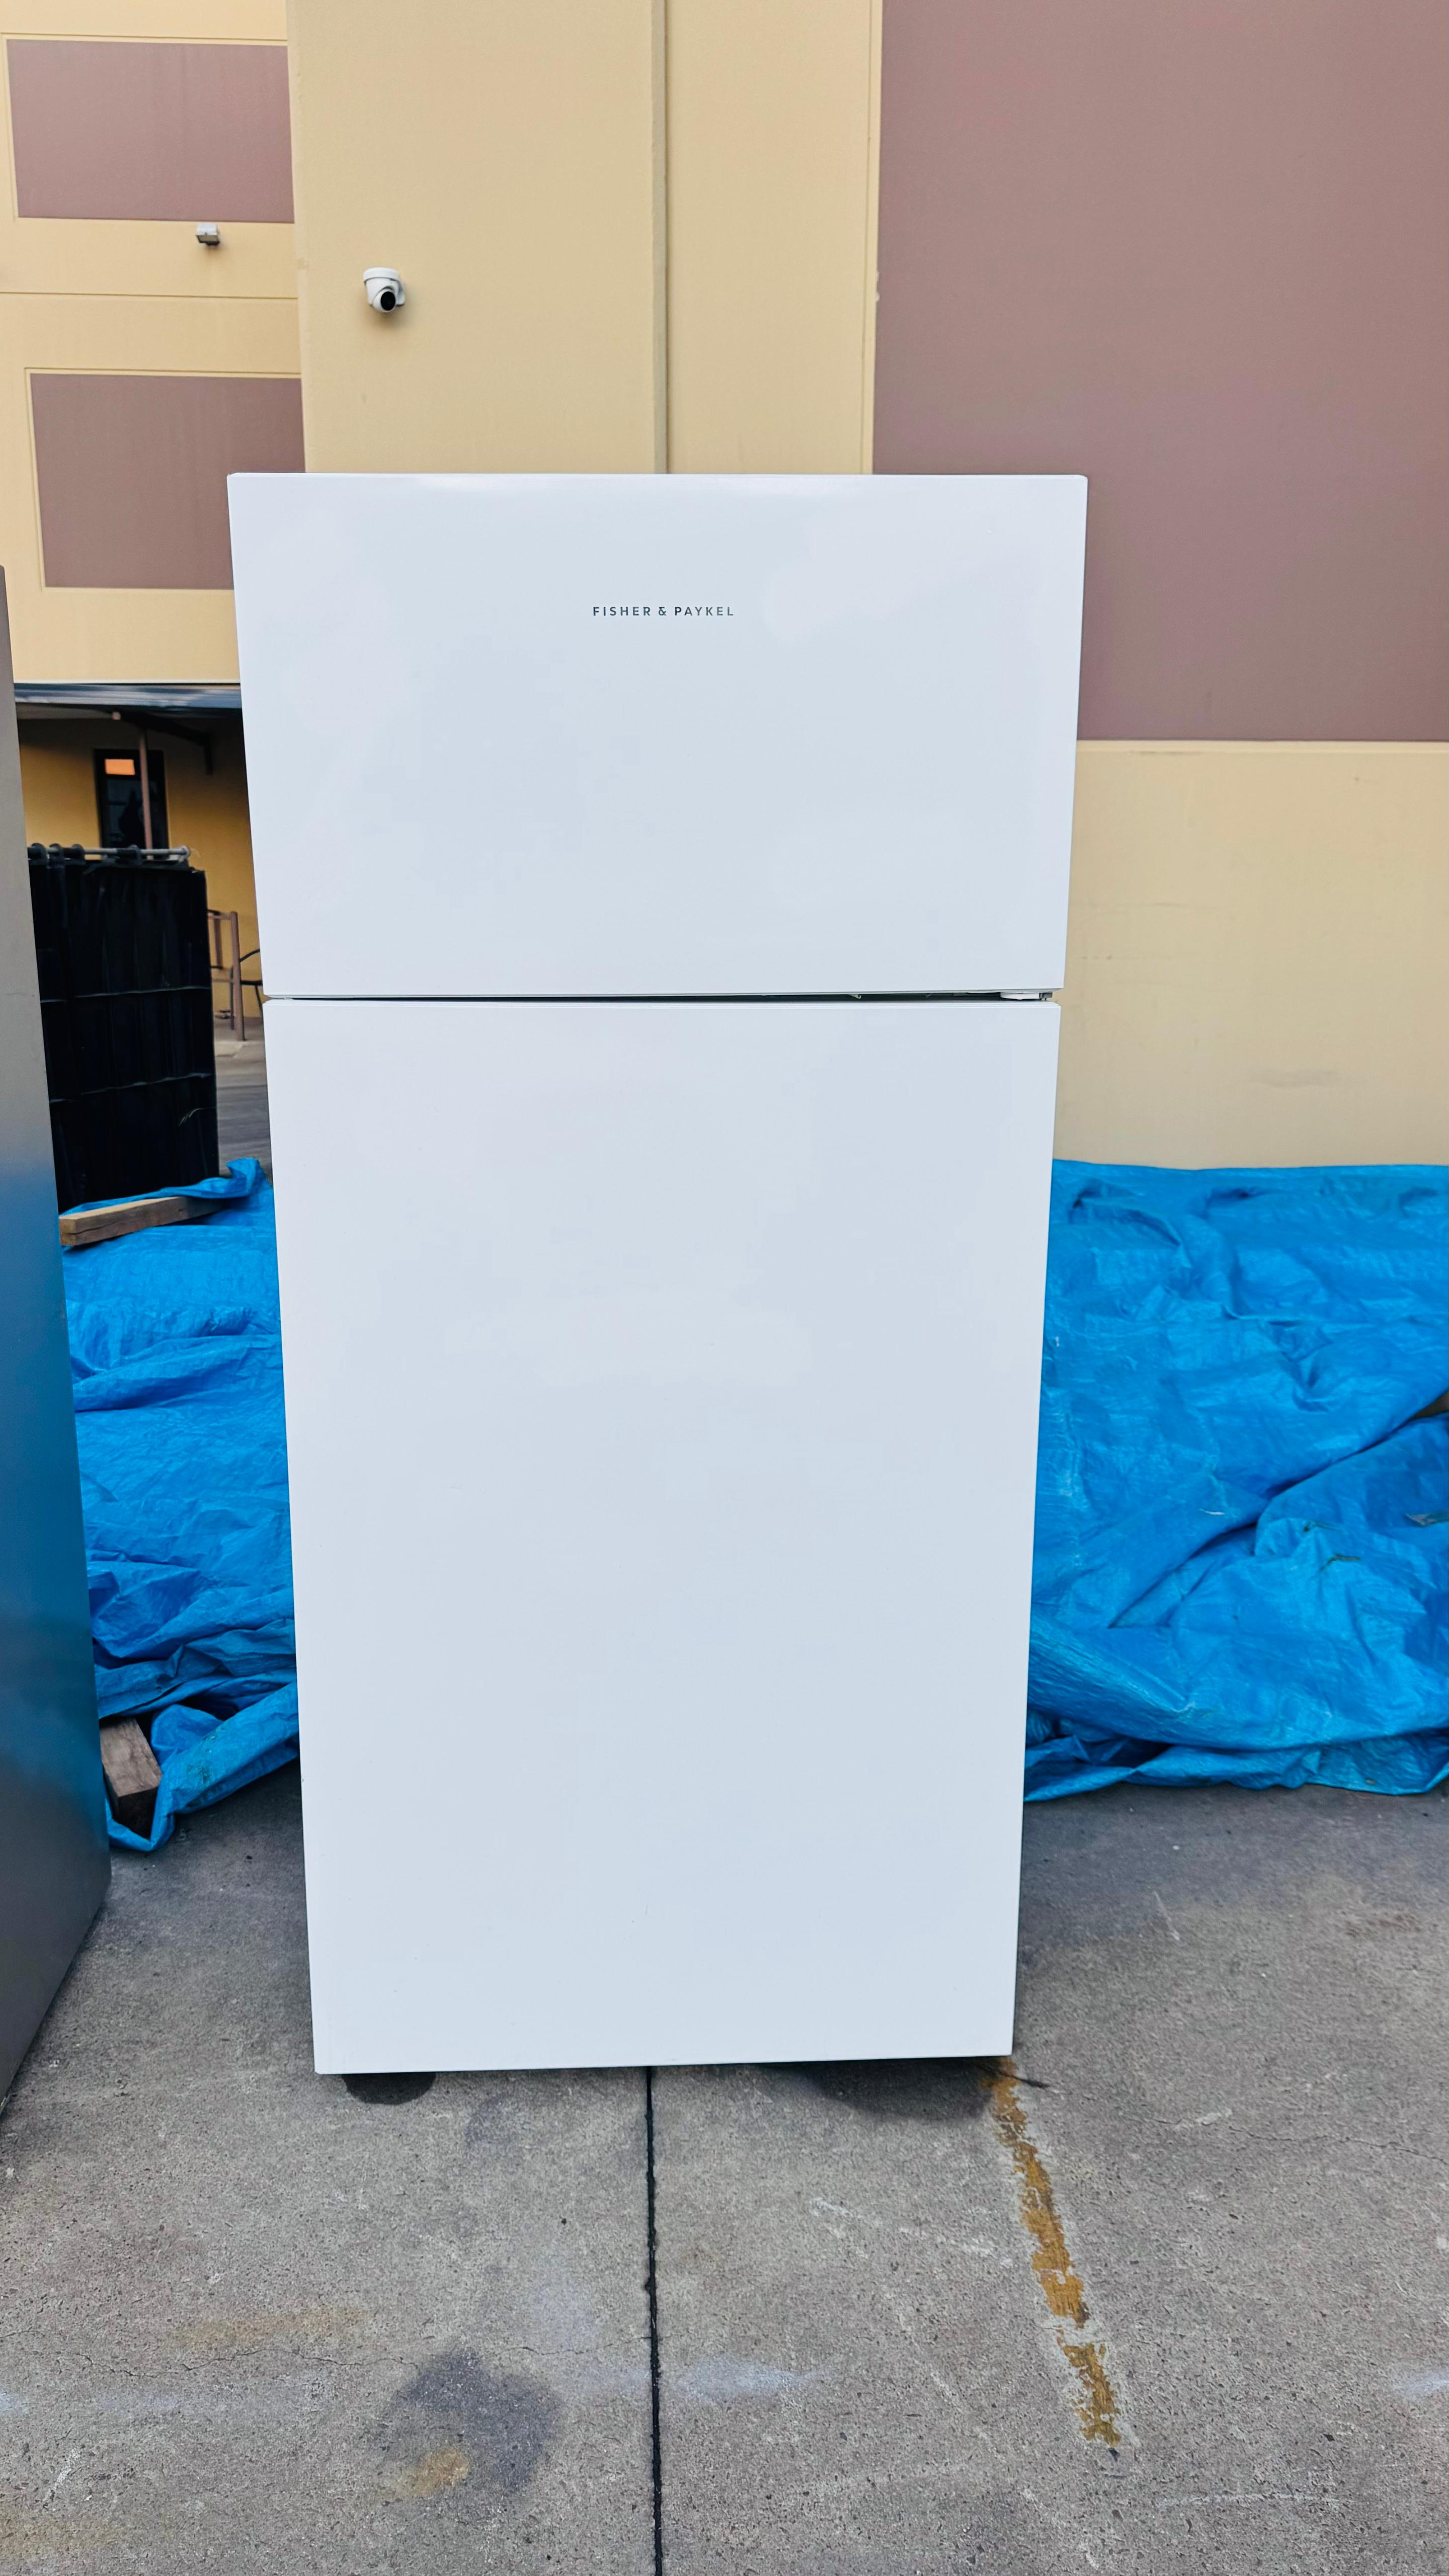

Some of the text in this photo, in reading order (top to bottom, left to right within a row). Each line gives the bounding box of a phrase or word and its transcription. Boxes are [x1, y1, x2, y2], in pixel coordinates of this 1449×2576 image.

[593, 606, 734, 616] FISHER & PAYKEL
